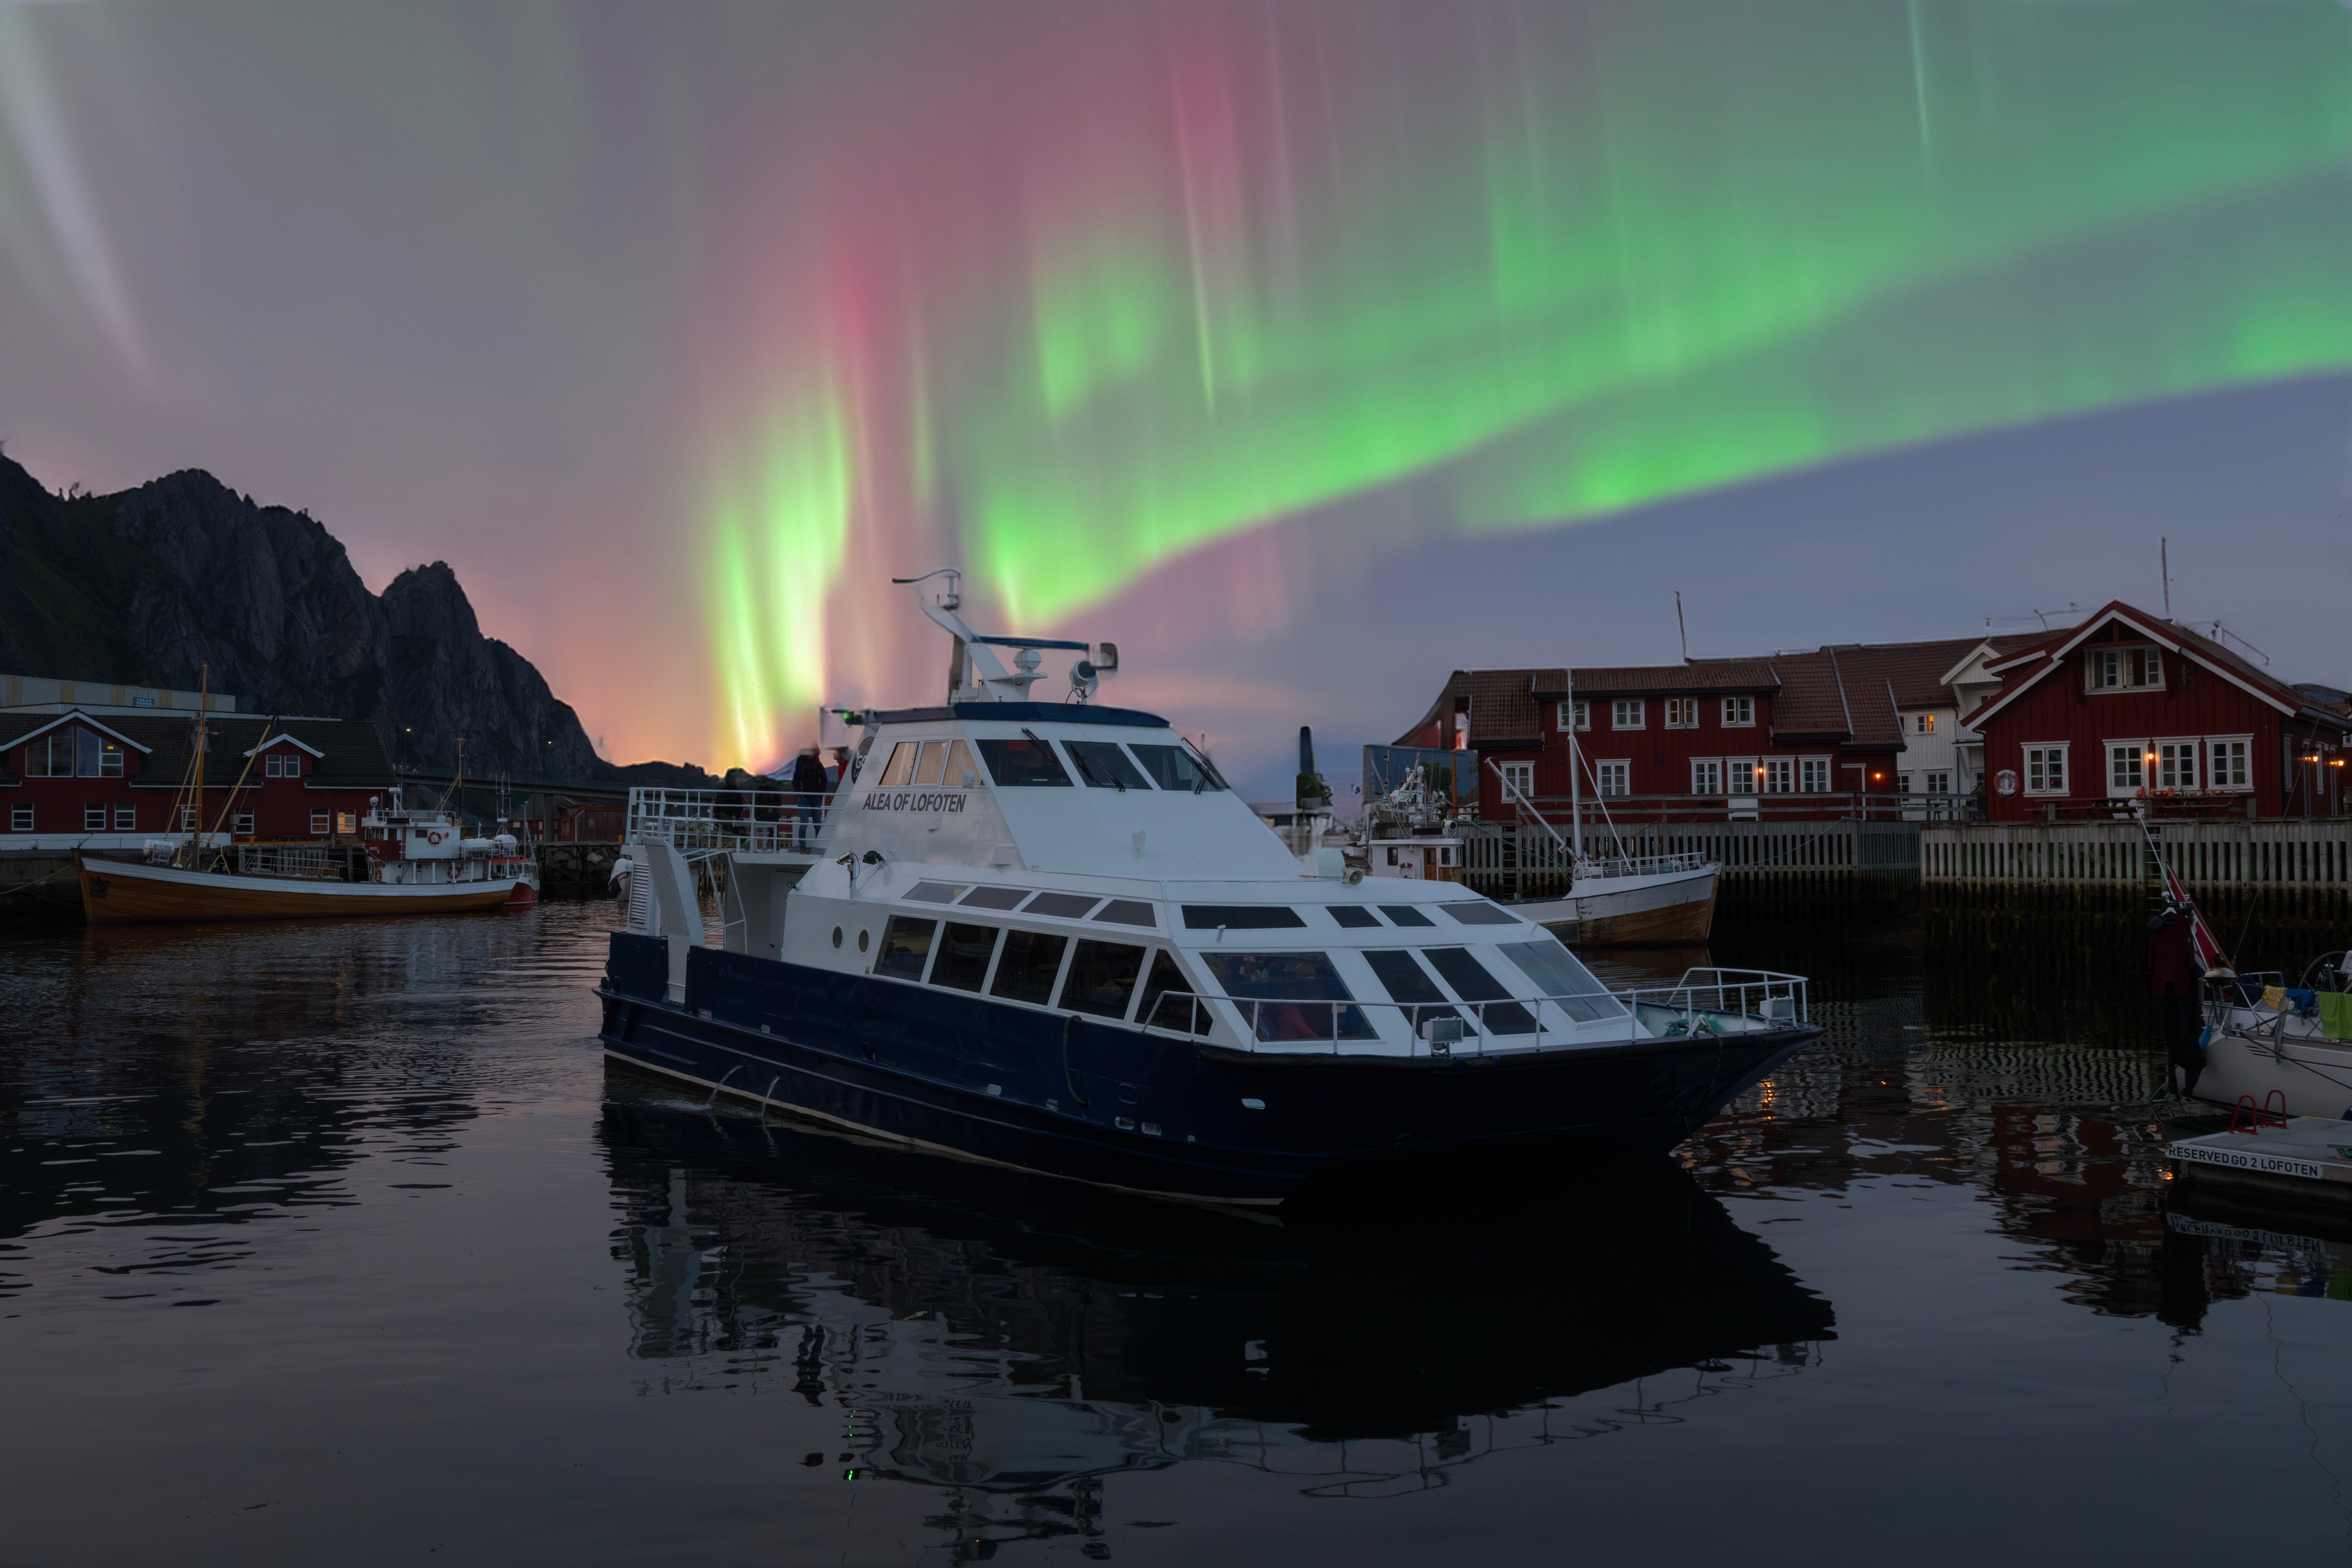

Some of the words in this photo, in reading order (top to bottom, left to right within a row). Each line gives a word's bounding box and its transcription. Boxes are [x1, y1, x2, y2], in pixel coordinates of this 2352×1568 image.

[862, 793, 890, 810] ALEA
[893, 793, 910, 811] OF
[910, 793, 967, 812] LOFOTEN
[2169, 1147, 2229, 1163] RESERVED
[2231, 1155, 2247, 1166] GO
[2251, 1158, 2257, 1167] 2
[2261, 1159, 2318, 1176] LOFOTEN
